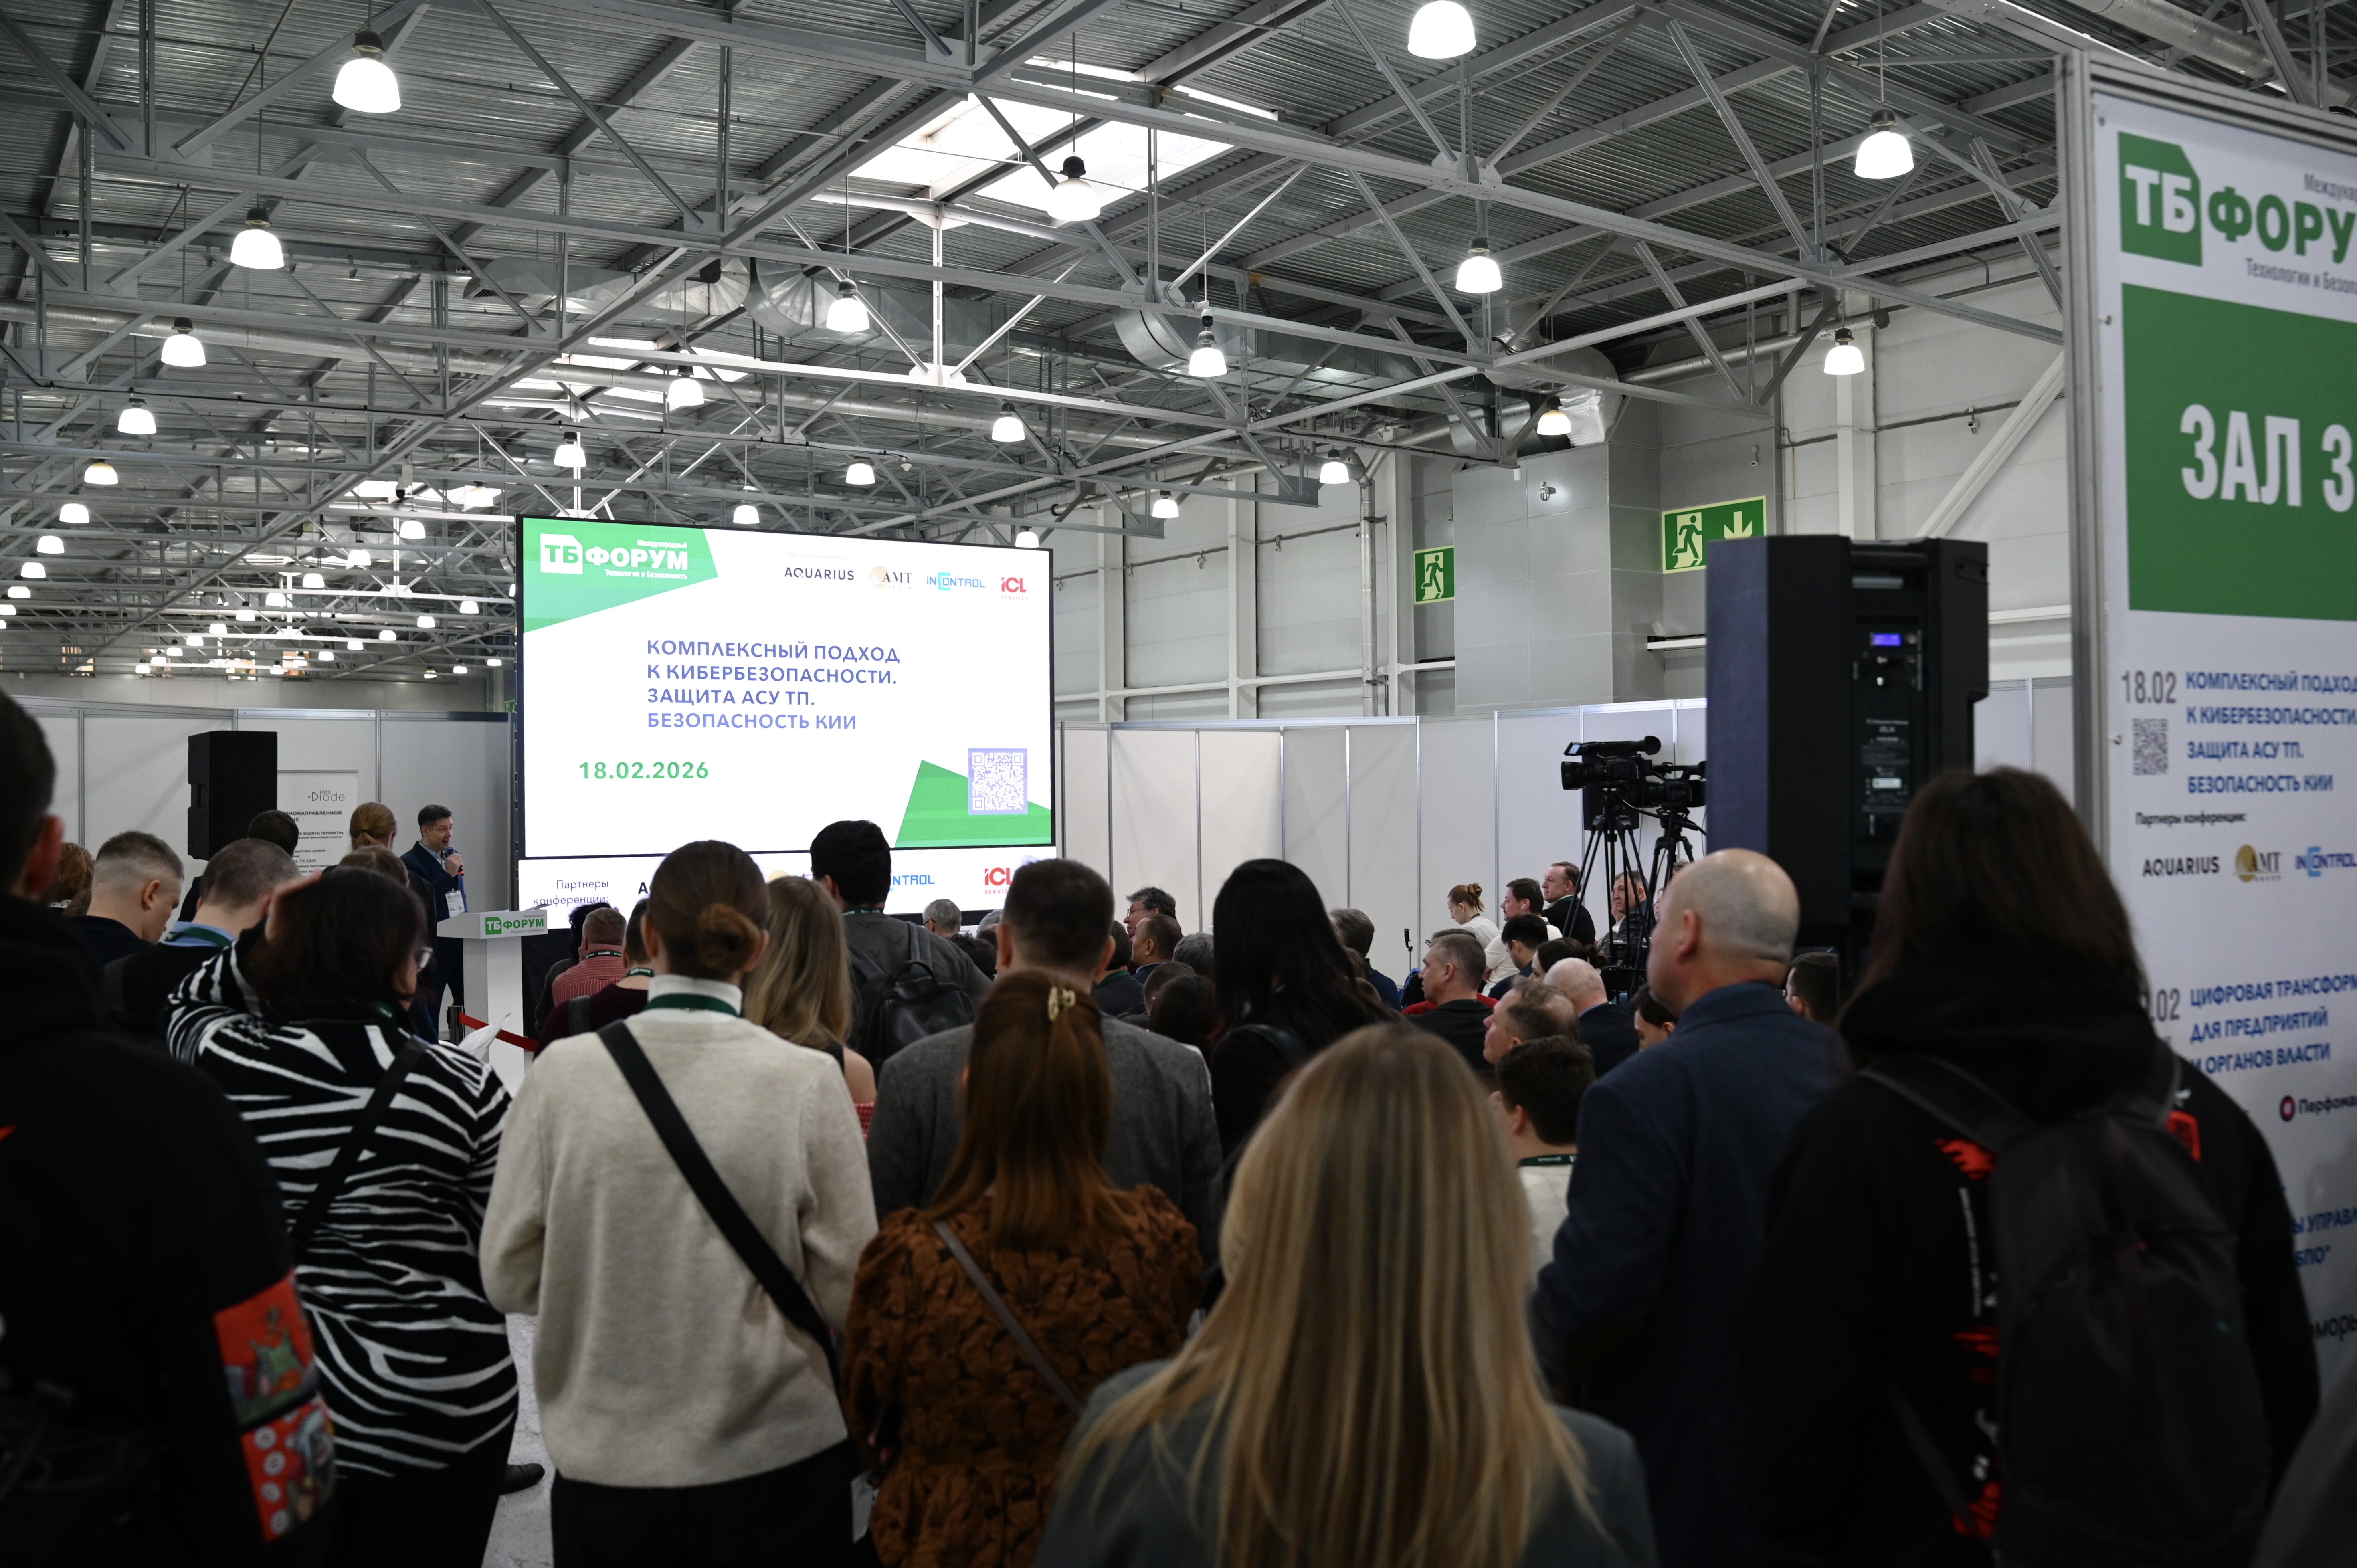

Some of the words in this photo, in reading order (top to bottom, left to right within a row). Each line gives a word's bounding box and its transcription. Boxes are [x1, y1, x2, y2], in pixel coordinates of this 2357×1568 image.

[2125, 164, 2197, 234] ТБ
[2208, 186, 2357, 265] ФОРУ
[2180, 403, 2302, 507] ЗАЛ
[2321, 423, 2354, 512] 3
[544, 544, 579, 564] ТБ
[585, 546, 688, 570] ФОРУМ
[647, 571, 688, 580] Безопасность
[784, 567, 855, 580] AQUARIUS
[882, 571, 912, 584] AMT
[647, 640, 807, 658] КОМПЛЕКСНЫЙ
[815, 645, 900, 664] ПОДХОД
[647, 664, 660, 678] К
[667, 665, 897, 684] КИБЕРБЕЗОПАСНОСТИ.
[647, 688, 736, 705] ЗАЩИТА
[741, 690, 780, 705] АСУ
[785, 691, 815, 705] ТП.
[2122, 671, 2177, 704] 18.02
[2186, 671, 2298, 691] КОМПЛЕКСНЫЙ
[648, 713, 810, 729] БЕЗОПАСНОСТЬ
[816, 715, 856, 729] КИИ
[2187, 707, 2197, 724] К
[2187, 742, 2249, 761] ЗАЩИТА
[2253, 742, 2280, 758] АСУ
[580, 761, 709, 779] 18.02.2026
[2188, 775, 2300, 793] БЕЗОПАСНОСТЬ
[2304, 775, 2333, 791] КИИ
[2143, 857, 2220, 877] AQUARIUS
[557, 880, 608, 891] Партнеры
[534, 895, 608, 907] конференции:
[486, 920, 501, 931] ТБ
[503, 918, 544, 929] ФОРУМ
[2190, 982, 2273, 1008] ЦИФРОВАЯ
[2190, 1022, 2221, 1043] ДЛЯ
[2225, 1006, 2328, 1037] ПРЕДПРИЯТИЙ
[2206, 1049, 2273, 1073] ОРГАНОВ
[2278, 1043, 2331, 1065] ВЛАСТИ
[2299, 1095, 2357, 1115] Перфома
